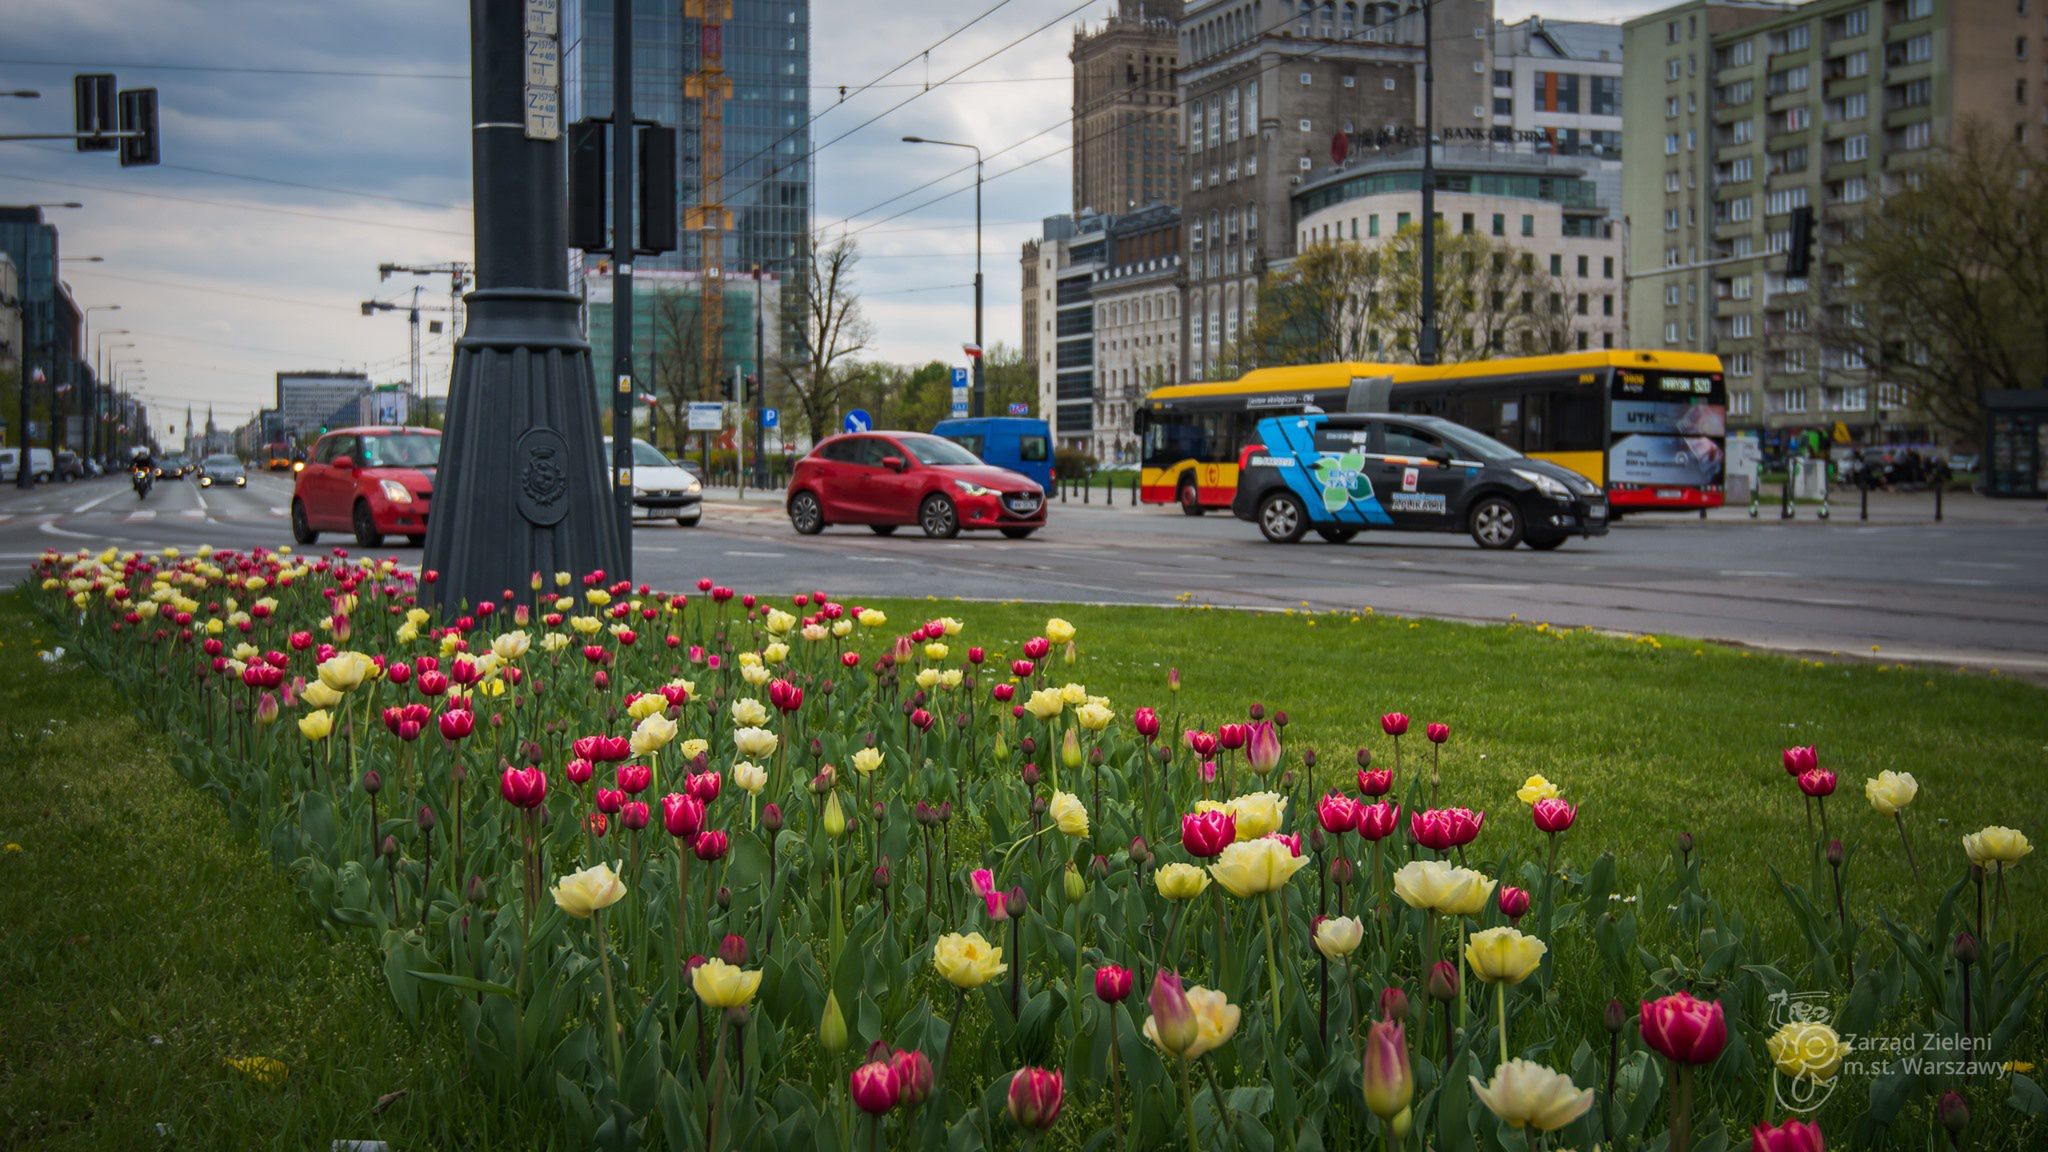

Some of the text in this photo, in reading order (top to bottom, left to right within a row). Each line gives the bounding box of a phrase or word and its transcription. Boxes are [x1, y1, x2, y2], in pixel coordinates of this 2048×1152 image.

[1443, 126, 1488, 140] BANK
[1694, 377, 1712, 394] 520
[1328, 469, 1357, 478] EKO
[1329, 479, 1358, 490] TAXI
